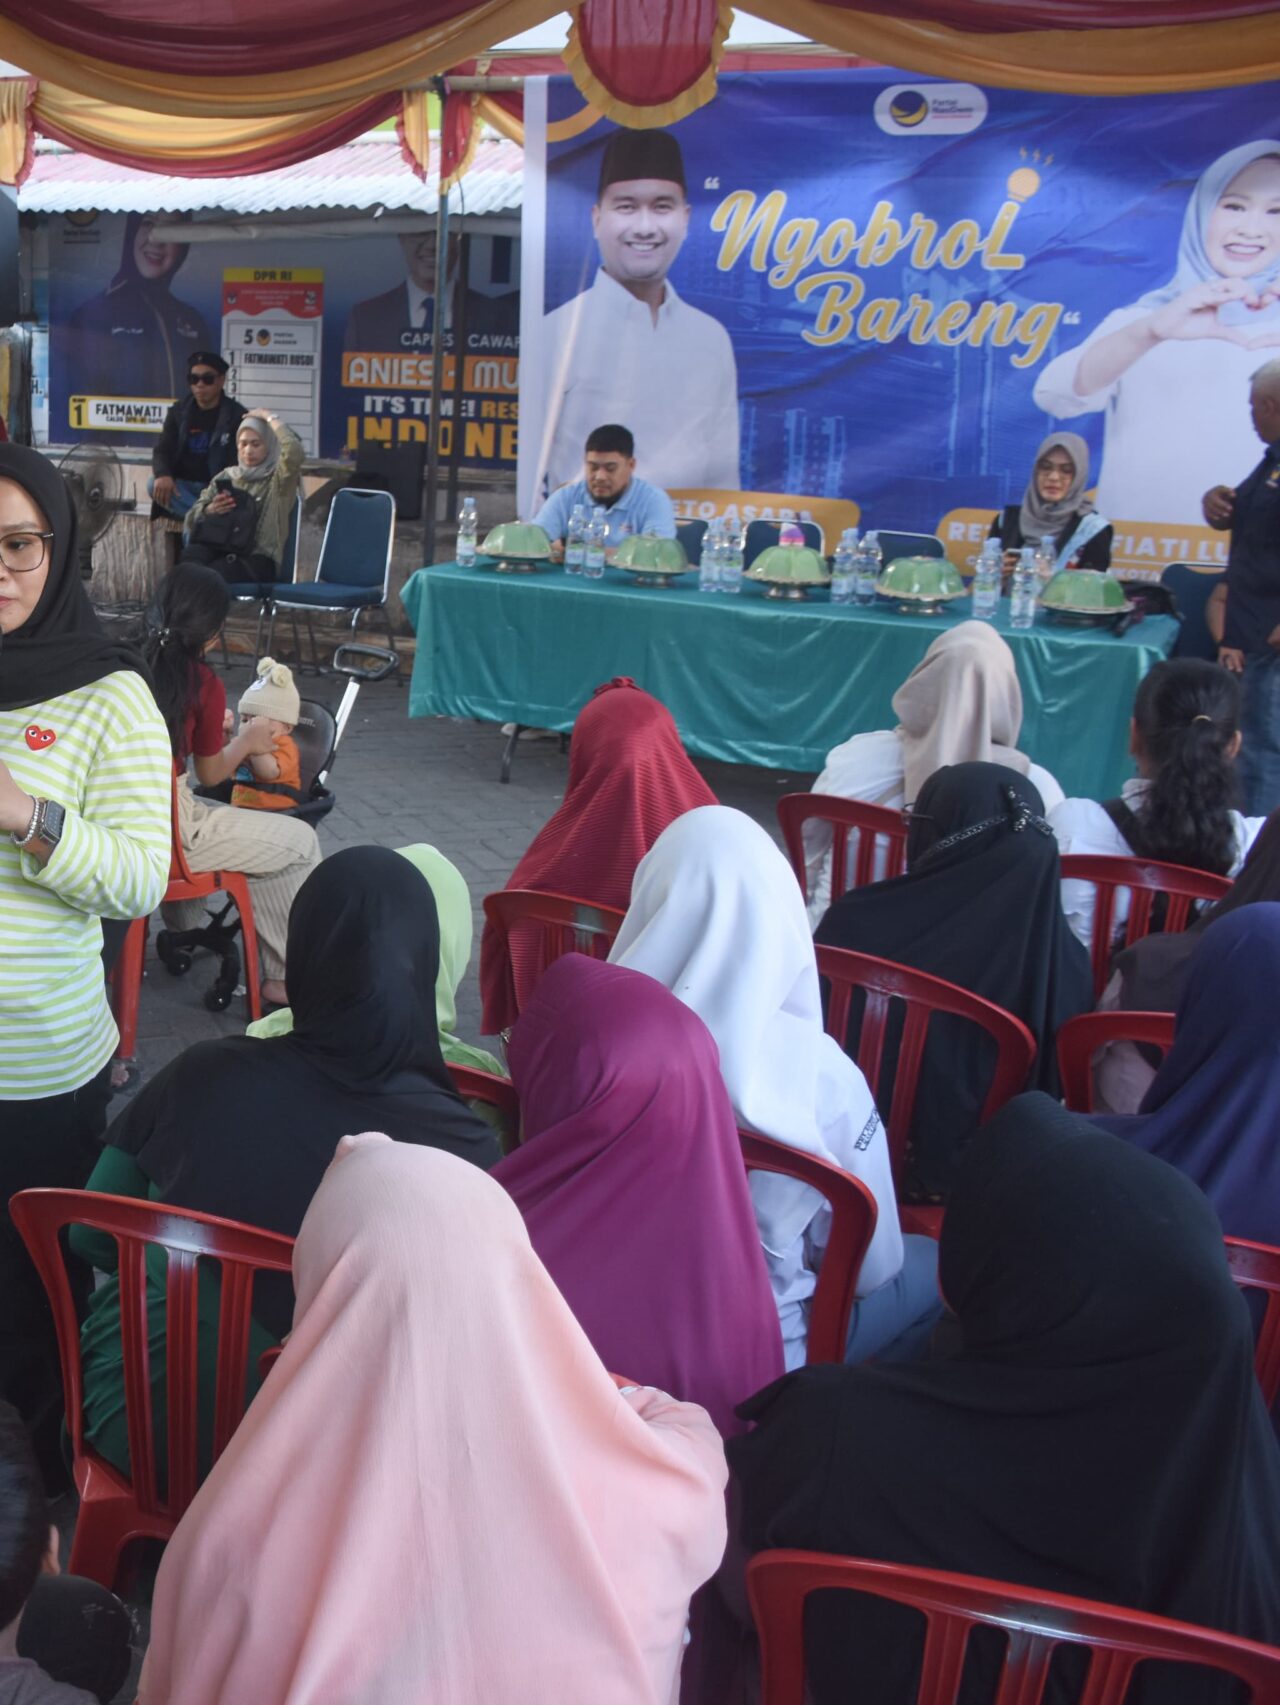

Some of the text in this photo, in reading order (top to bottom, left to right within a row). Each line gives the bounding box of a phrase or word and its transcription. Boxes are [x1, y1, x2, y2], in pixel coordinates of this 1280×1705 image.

[253, 270, 292, 281] DPR RI
[243, 328, 253, 345] 5
[400, 332, 454, 347] CAPS
[229, 351, 234, 365] 1
[473, 360, 520, 389] MU
[74, 404, 82, 426] 1
[95, 403, 163, 417] FATMAWATI
[363, 395, 406, 414] IT'S
[480, 400, 520, 419] RES
[347, 416, 519, 460] INDONE
[672, 499, 717, 520] ETO
[1110, 534, 1190, 560] FIATI
